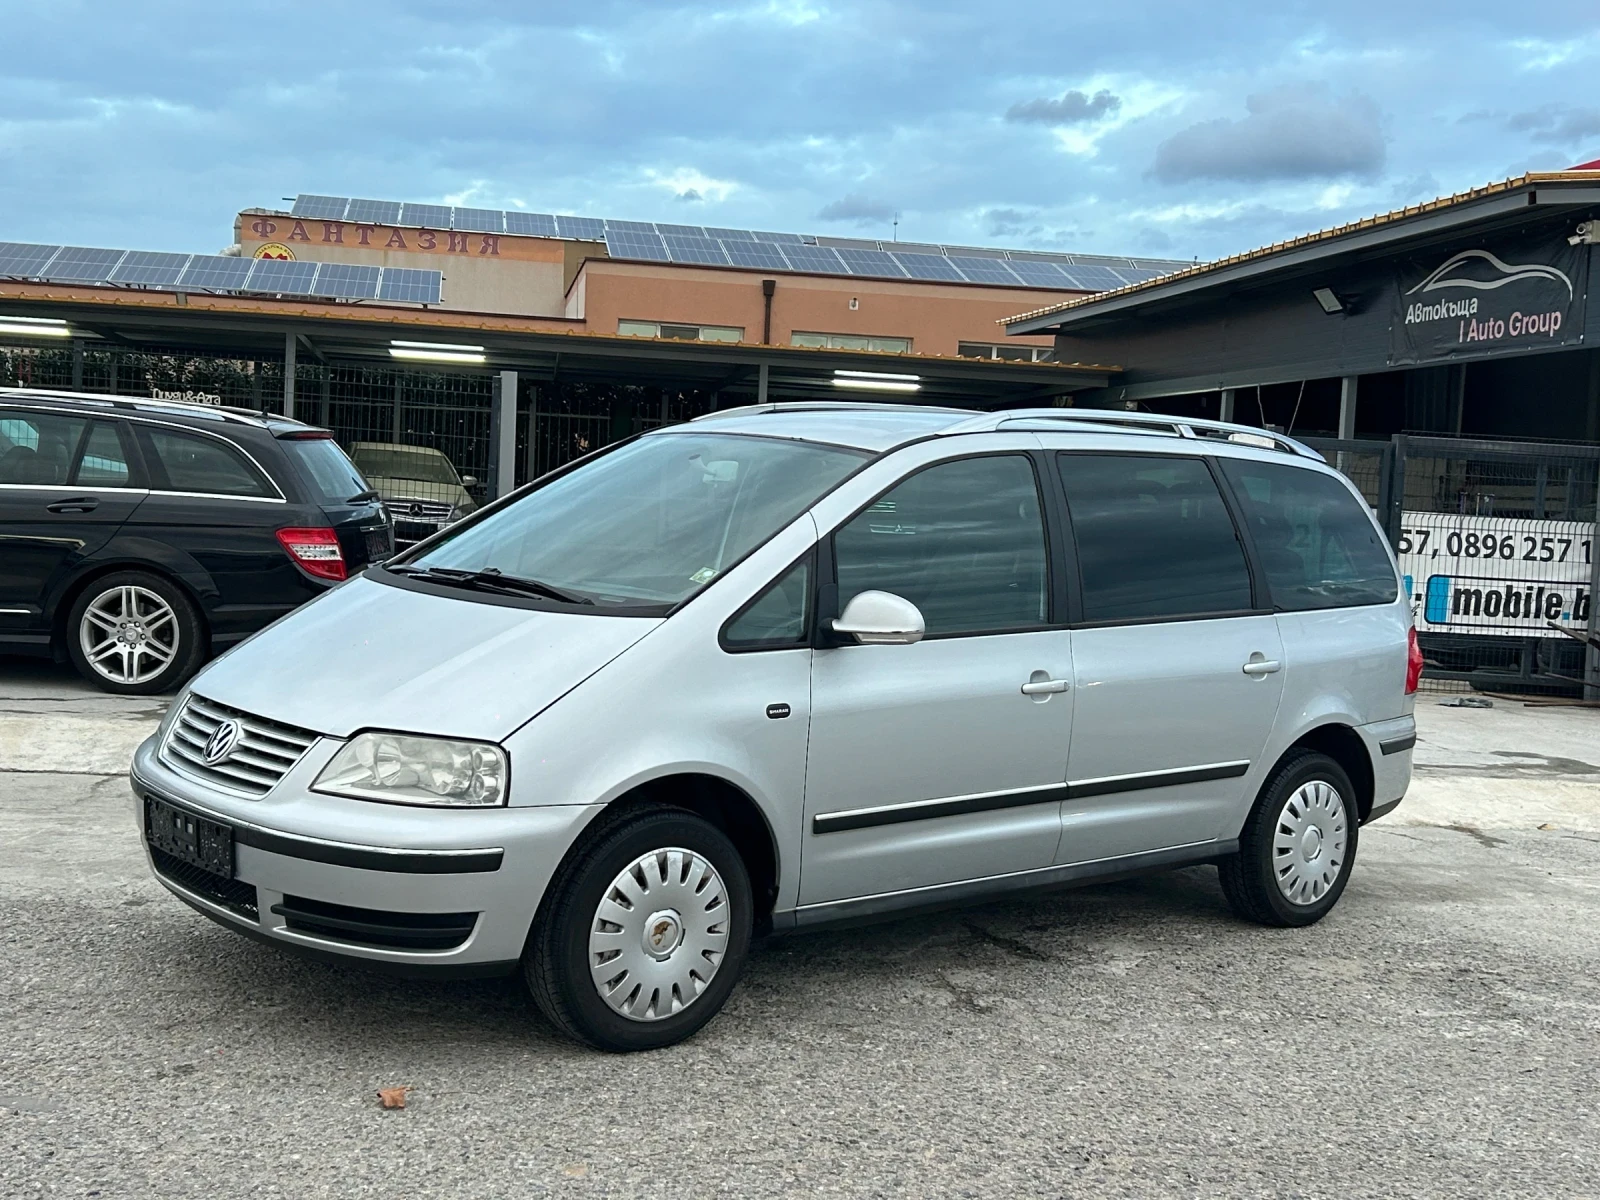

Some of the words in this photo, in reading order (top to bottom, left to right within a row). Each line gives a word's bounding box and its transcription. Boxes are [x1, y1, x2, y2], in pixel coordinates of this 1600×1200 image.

[251, 217, 500, 255] ФАНТАЗИЯ
[1404, 297, 1479, 325] Автокъща
[1467, 317, 1505, 342] Auto
[1508, 310, 1562, 338] Group
[1446, 531, 1515, 560] 0896
[1522, 535, 1572, 563] 257
